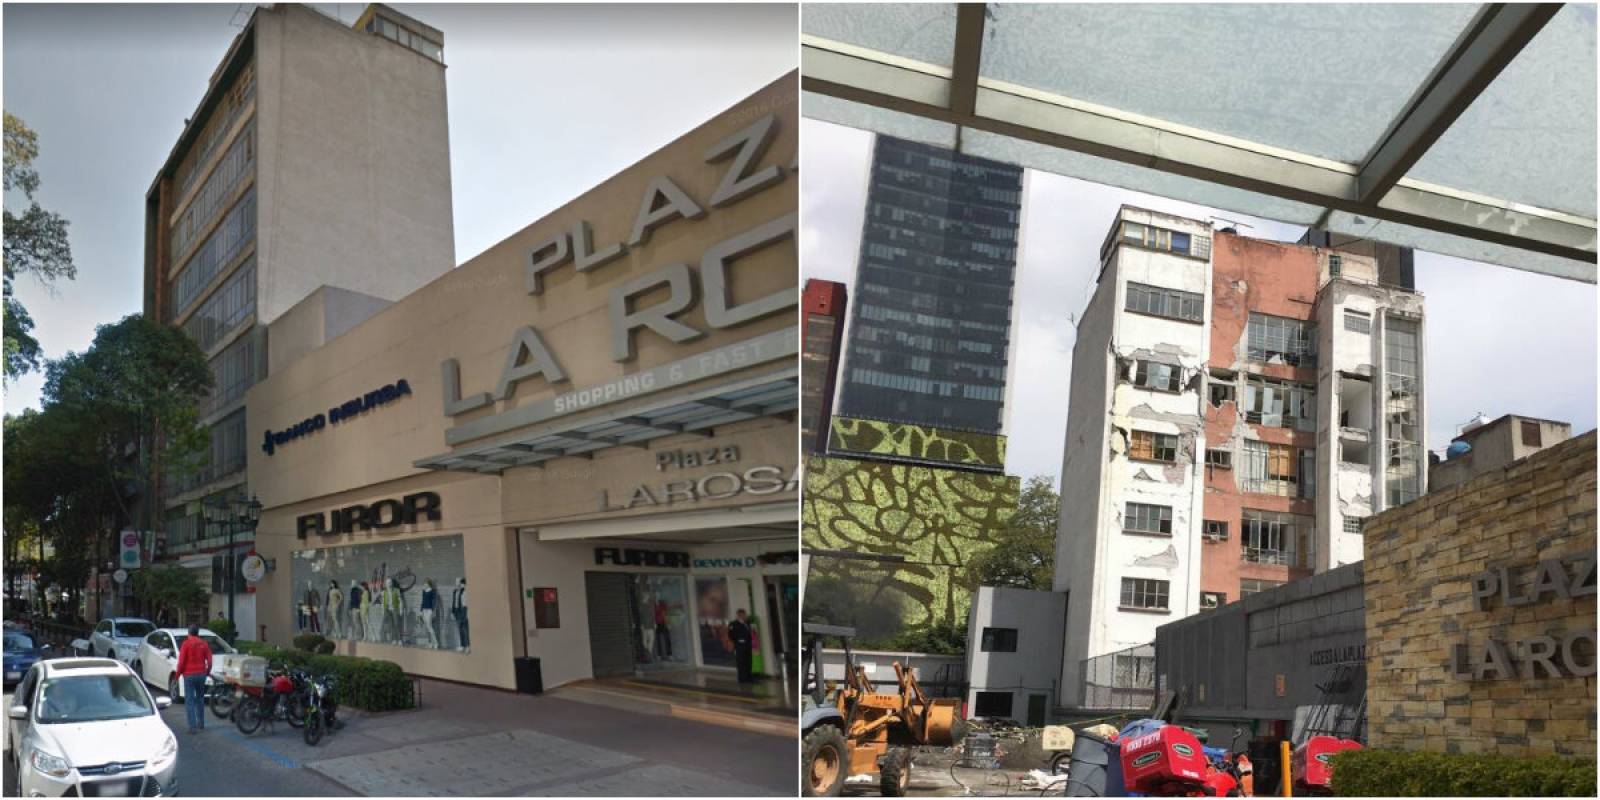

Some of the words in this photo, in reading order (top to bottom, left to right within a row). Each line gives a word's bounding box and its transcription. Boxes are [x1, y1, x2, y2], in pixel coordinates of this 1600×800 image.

[525, 113, 798, 296] PLAZ
[441, 325, 568, 417] LA
[554, 373, 655, 413] SHOPPING
[700, 342, 764, 374] FAST
[656, 444, 739, 472] Plaza
[296, 491, 442, 541] FUROR
[594, 547, 690, 569] FUROR
[693, 557, 743, 569] DEVLYN
[1451, 638, 1507, 682] LA
